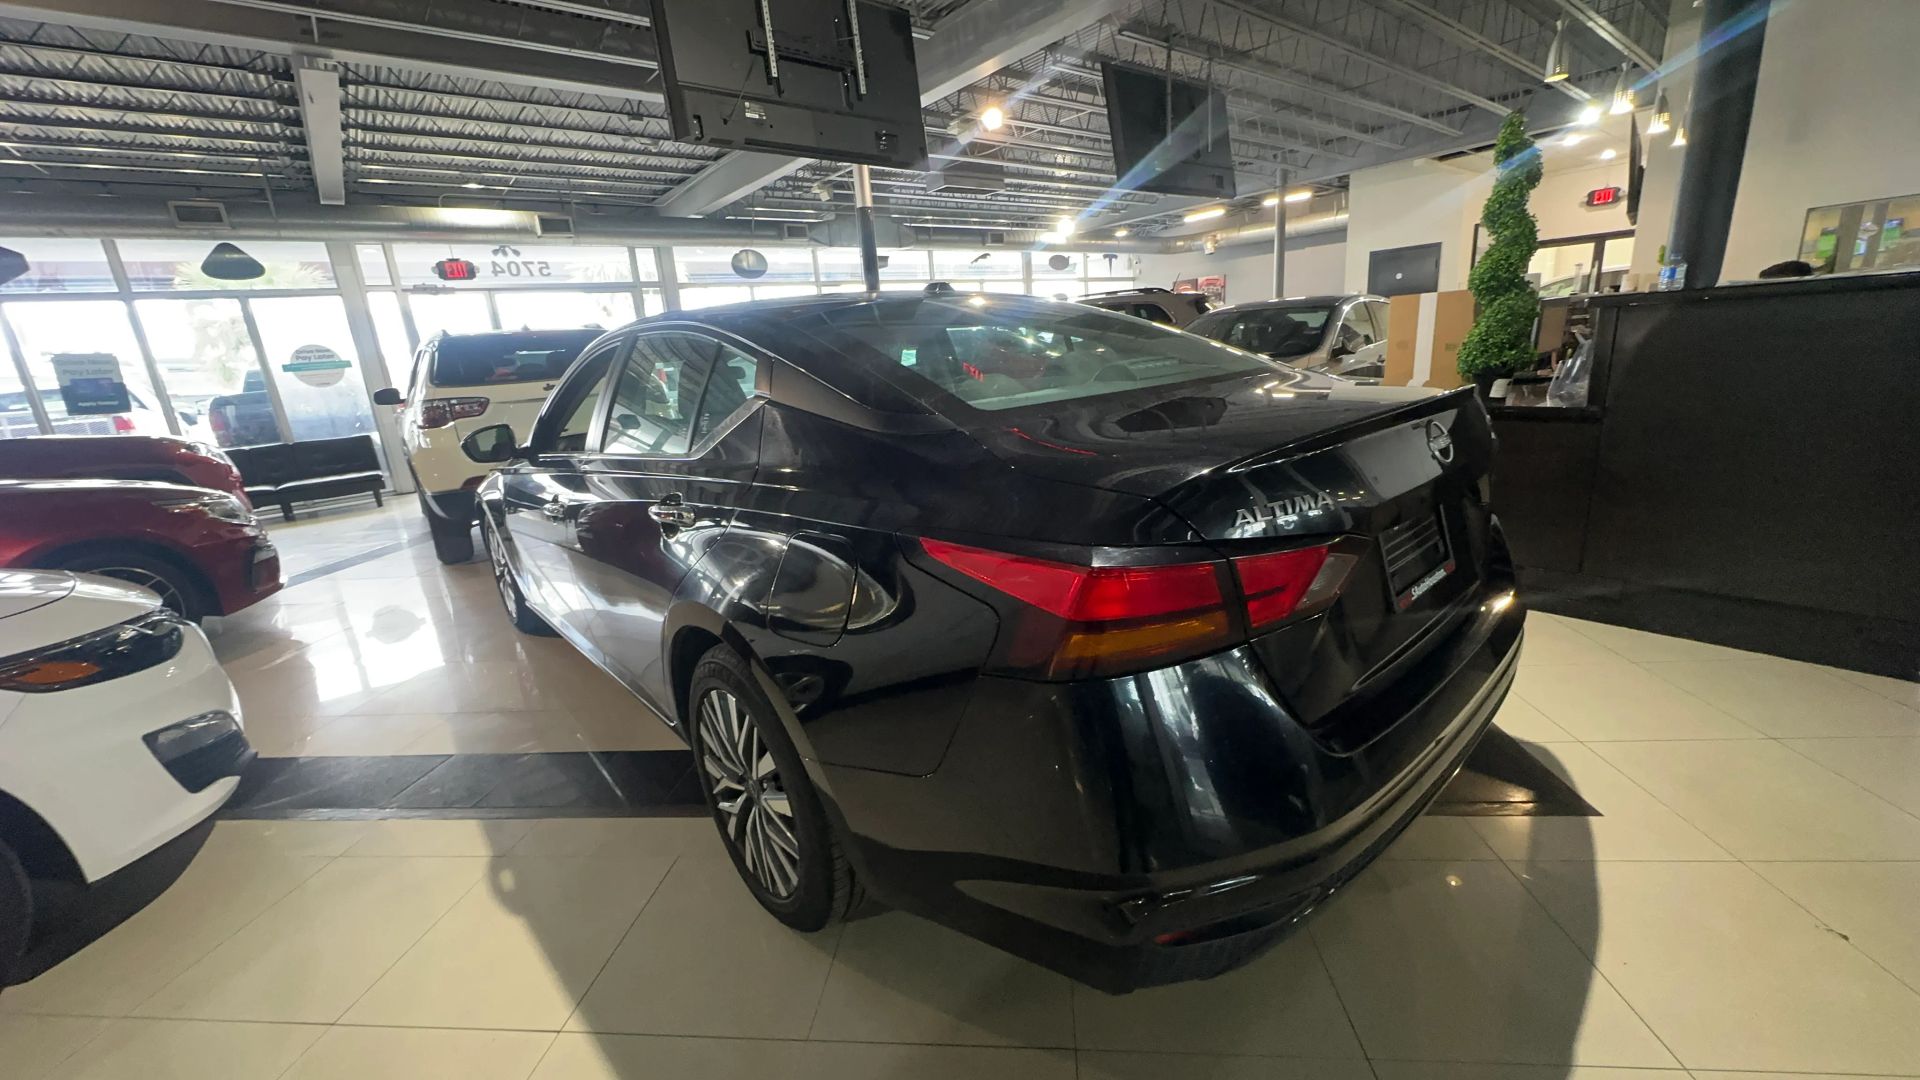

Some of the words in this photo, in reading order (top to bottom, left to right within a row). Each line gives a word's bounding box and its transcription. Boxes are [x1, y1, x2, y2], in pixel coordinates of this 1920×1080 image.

[61, 368, 84, 377] Pay
[86, 367, 113, 375] Later
[1234, 491, 1335, 527] ALTIMA
